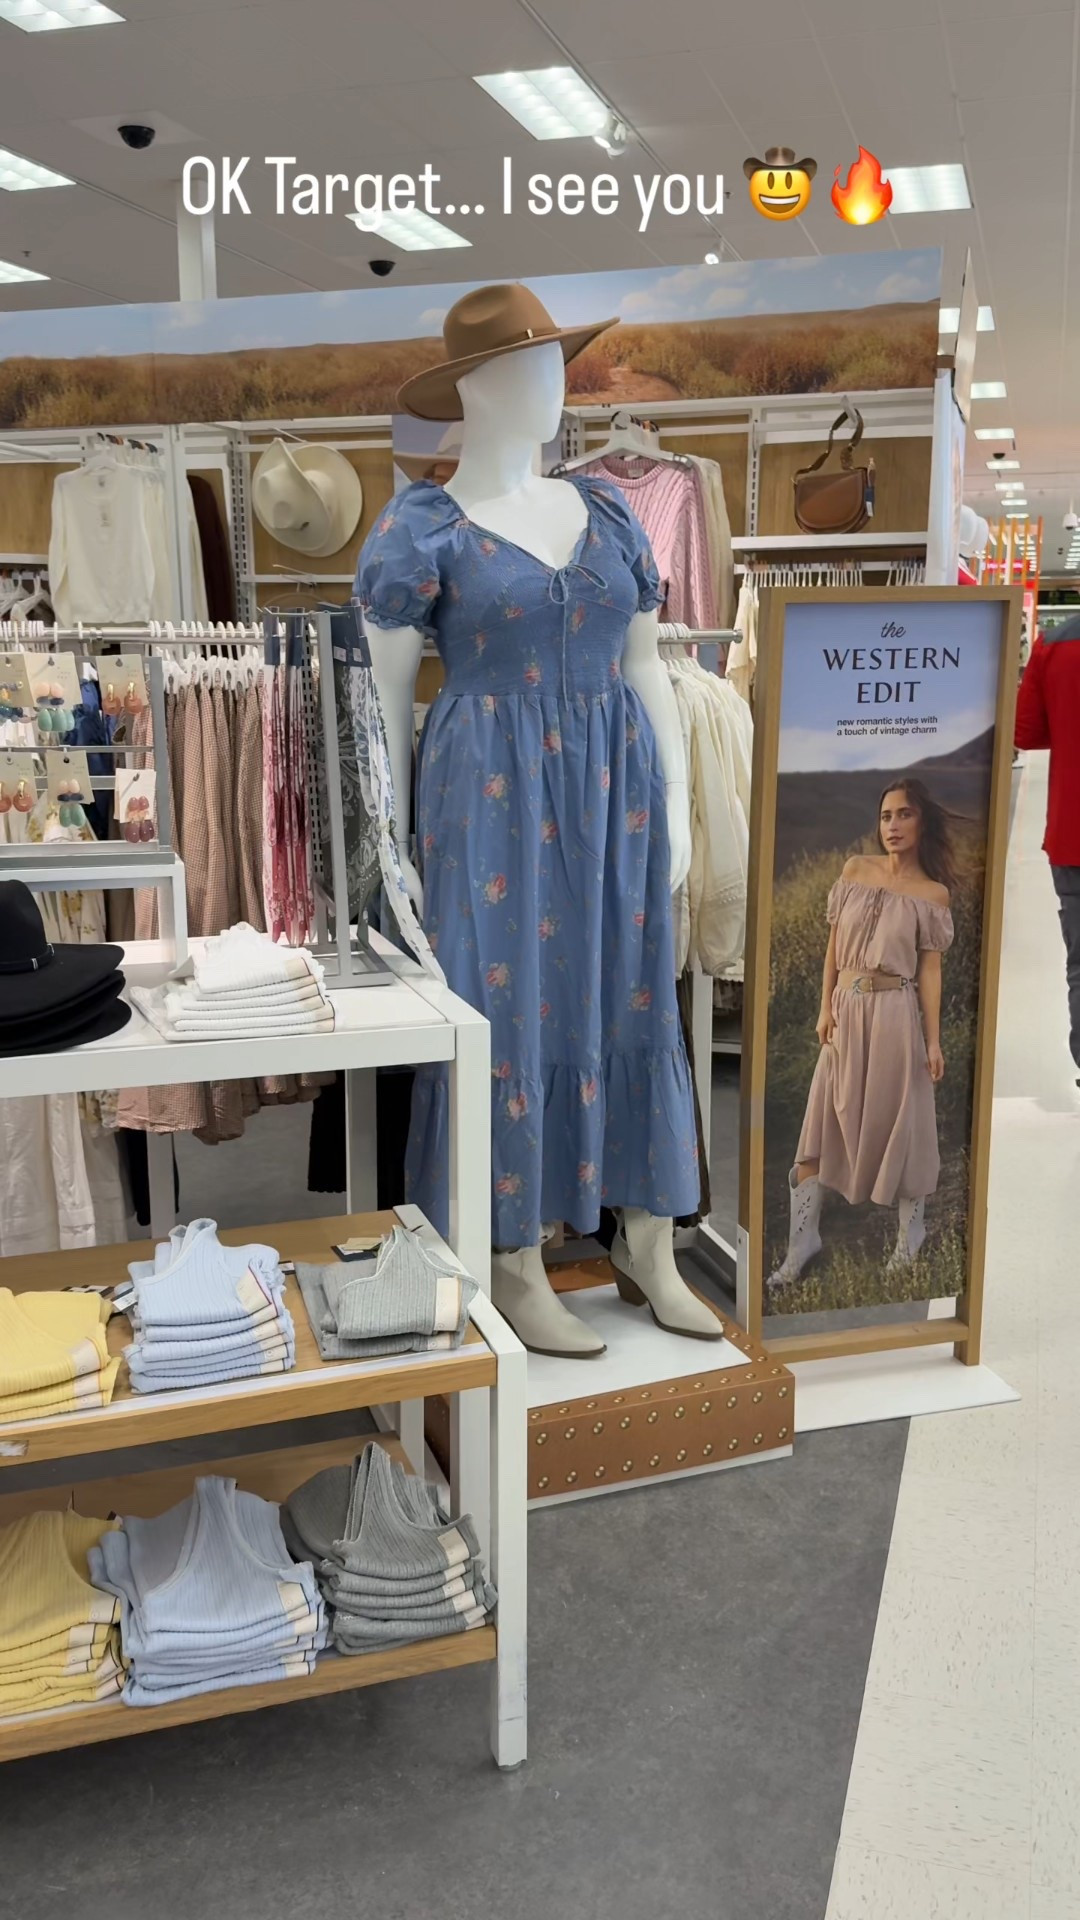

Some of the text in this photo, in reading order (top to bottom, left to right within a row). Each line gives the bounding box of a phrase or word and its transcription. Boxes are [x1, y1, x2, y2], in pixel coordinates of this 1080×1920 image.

[880, 621, 906, 638] the
[823, 647, 960, 671] WESTERN
[857, 681, 921, 704] EDIT
[836, 715, 938, 727] new romantic styles with
[844, 727, 868, 736] touch
[869, 727, 878, 736] of
[879, 727, 910, 737] vintage
[911, 726, 937, 734] charm
